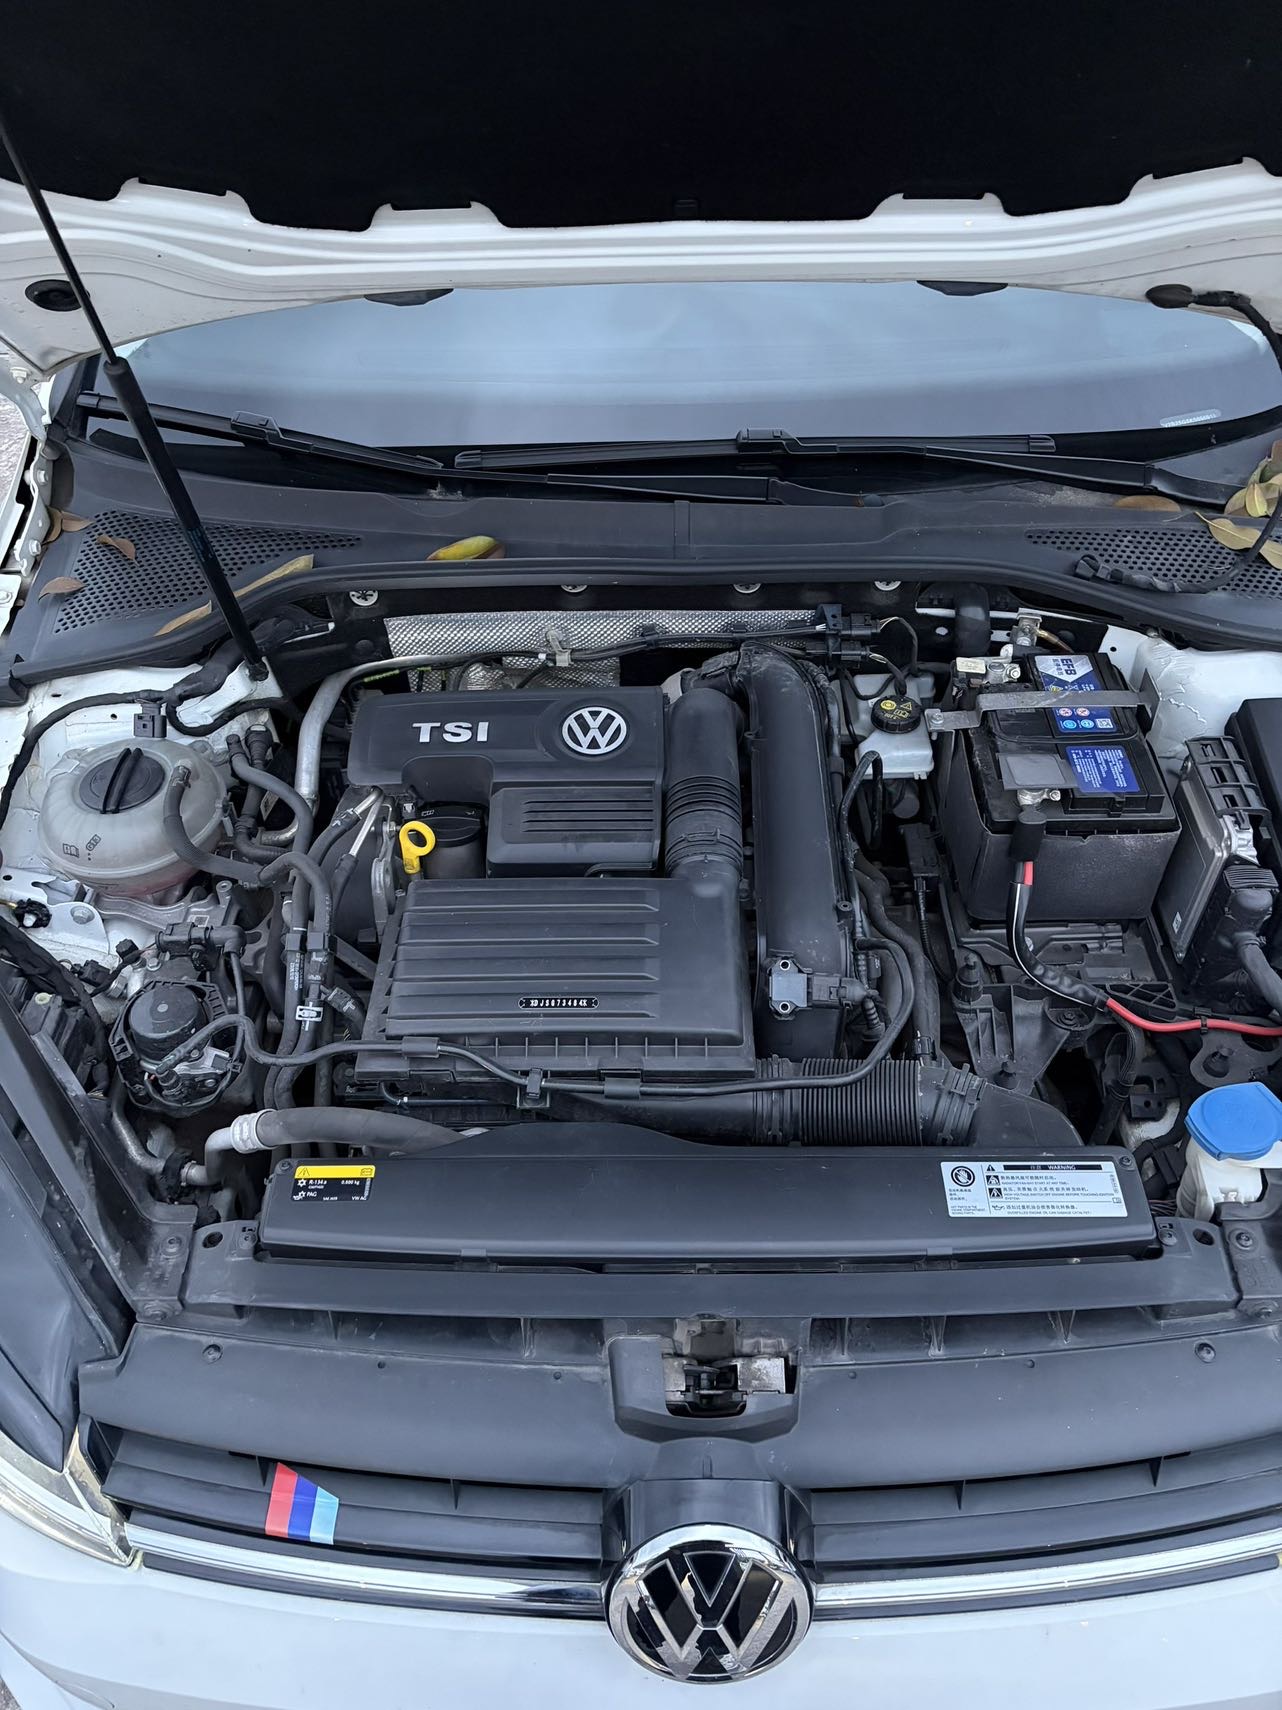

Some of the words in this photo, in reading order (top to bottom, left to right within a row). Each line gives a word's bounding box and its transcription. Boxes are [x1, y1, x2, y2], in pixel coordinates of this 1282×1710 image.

[1060, 658, 1077, 676] EFB
[412, 721, 490, 743] TSI
[562, 706, 627, 755] VW
[608, 1534, 810, 1682] VW
